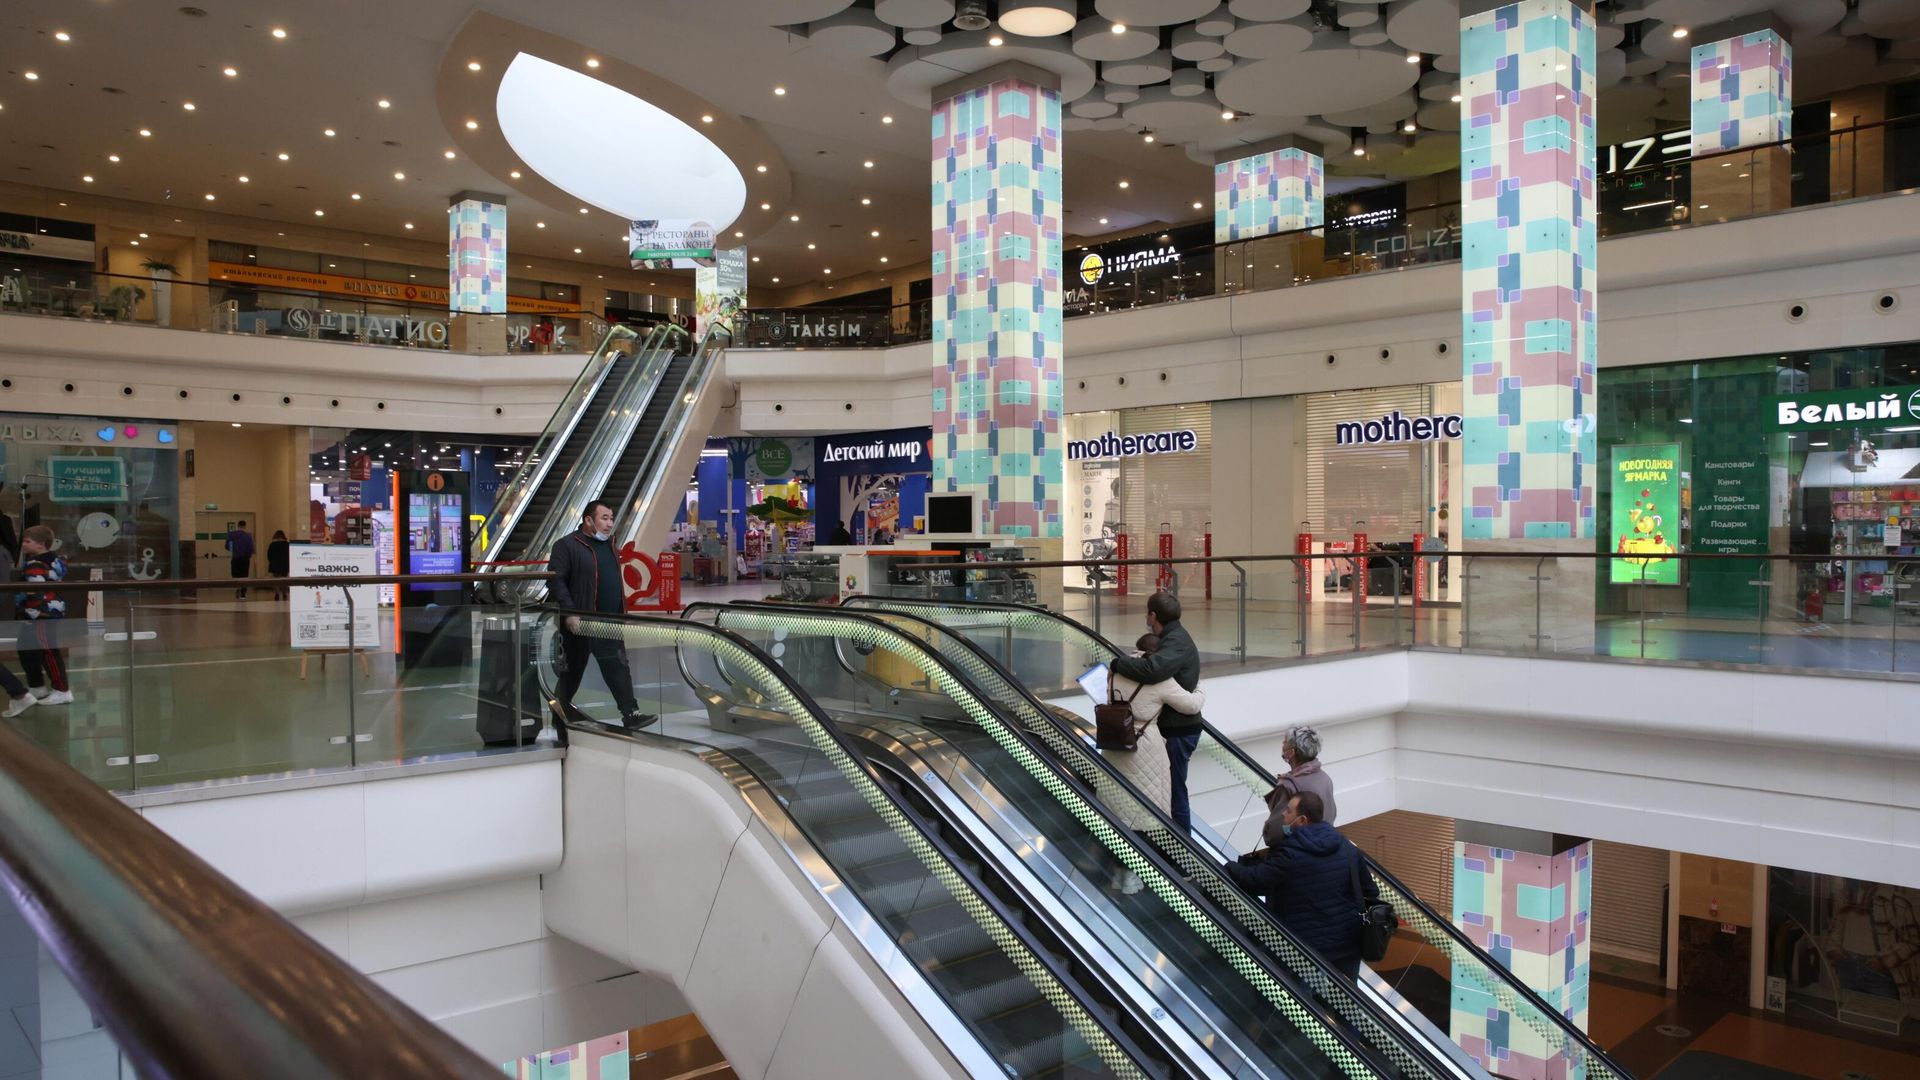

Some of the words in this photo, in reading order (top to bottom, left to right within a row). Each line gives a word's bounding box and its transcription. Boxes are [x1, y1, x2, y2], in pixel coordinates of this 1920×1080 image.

[652, 230, 709, 239] РЕСТОРАНЫ
[652, 241, 666, 249] НА
[668, 240, 712, 249] БАЛКОНЕ
[286, 277, 327, 285] ресторан
[338, 313, 447, 343] ПАТИО
[1778, 393, 1901, 425] Белый
[1336, 411, 1463, 445] motherc
[1067, 430, 1196, 460] mothercare
[823, 440, 885, 462] Детский
[887, 441, 922, 463] мир
[1619, 459, 1674, 471] НОВОГОДНЯЯ
[1704, 461, 1755, 469] Канцтовары
[1624, 472, 1668, 482] ЯРМАРКА
[1711, 520, 1748, 528] Подарки
[1701, 538, 1758, 546] Развивающие
[1718, 546, 1739, 554] игры
